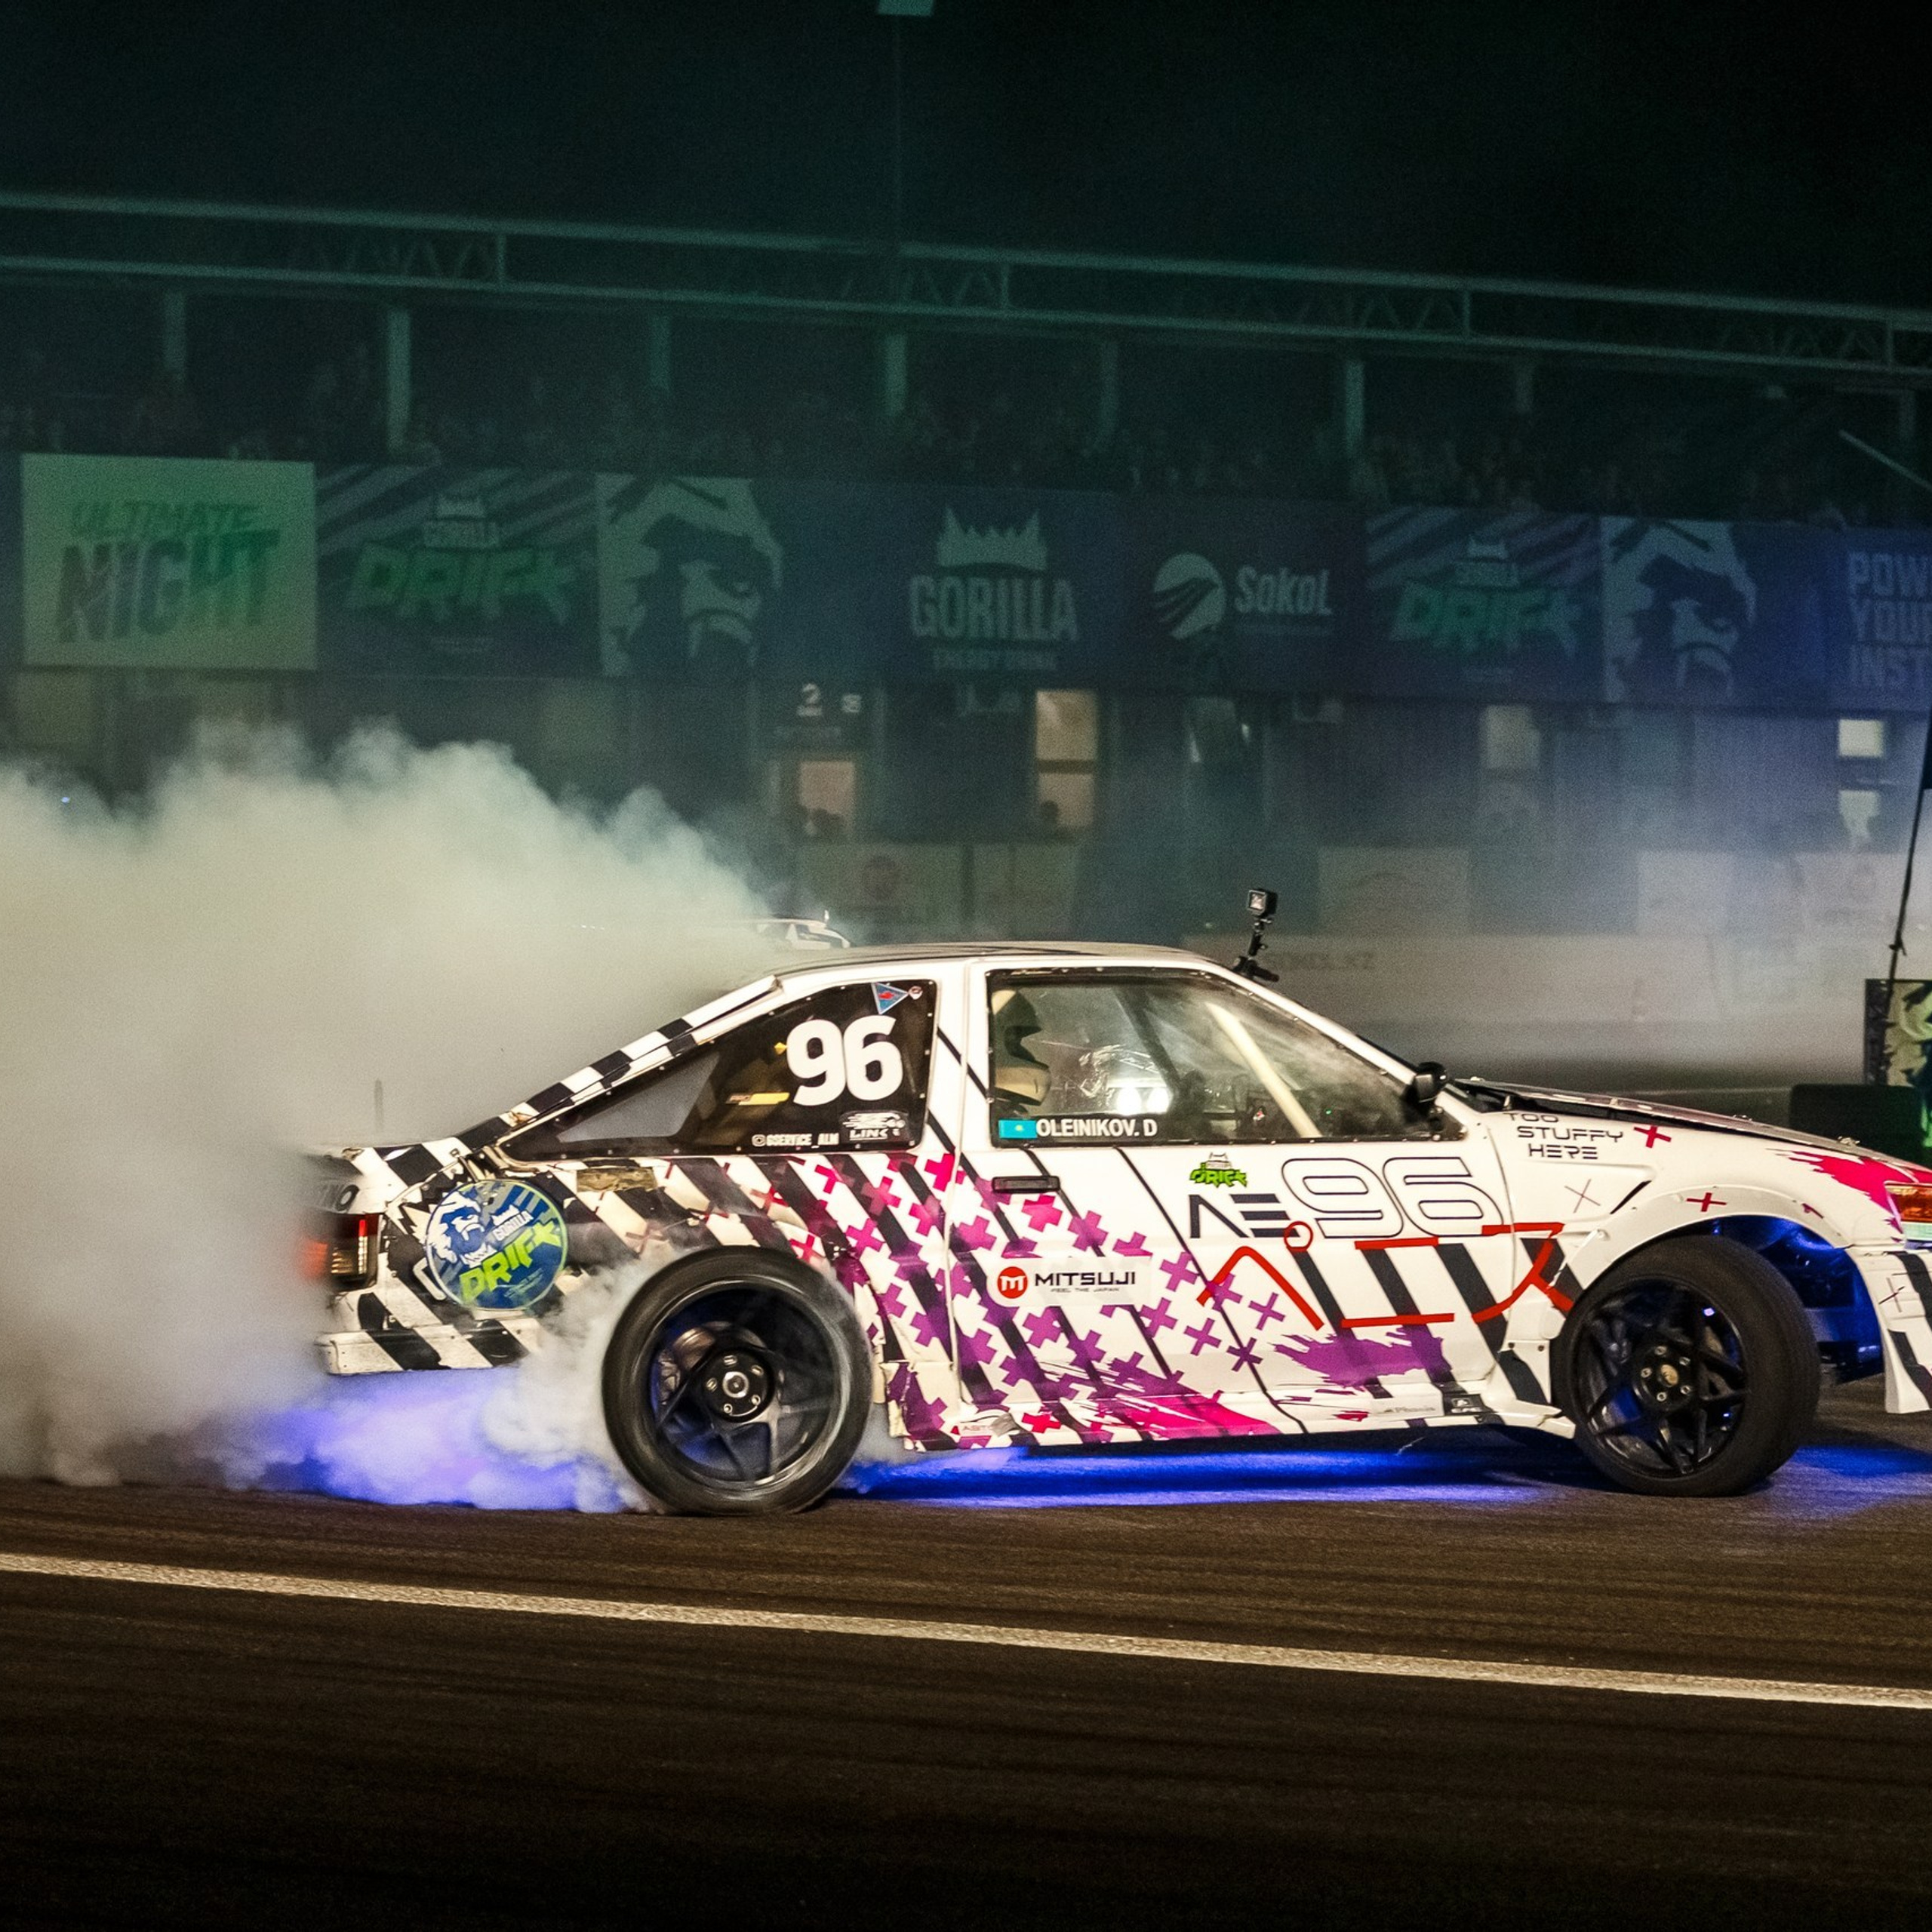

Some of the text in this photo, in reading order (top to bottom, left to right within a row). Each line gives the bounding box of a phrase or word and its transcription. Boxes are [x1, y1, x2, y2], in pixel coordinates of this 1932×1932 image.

[71, 500, 258, 536] ULTIMATE
[55, 528, 281, 643] NIGHT
[909, 574, 1078, 641] GORILLA
[786, 1014, 903, 1106] 96
[1503, 1112, 1559, 1123] TOO
[1036, 1118, 1158, 1137] OLEINIKOV. D
[1516, 1125, 1623, 1143] STUFFY
[1528, 1143, 1598, 1160] HERE
[1035, 1272, 1136, 1286] MITSUJI
